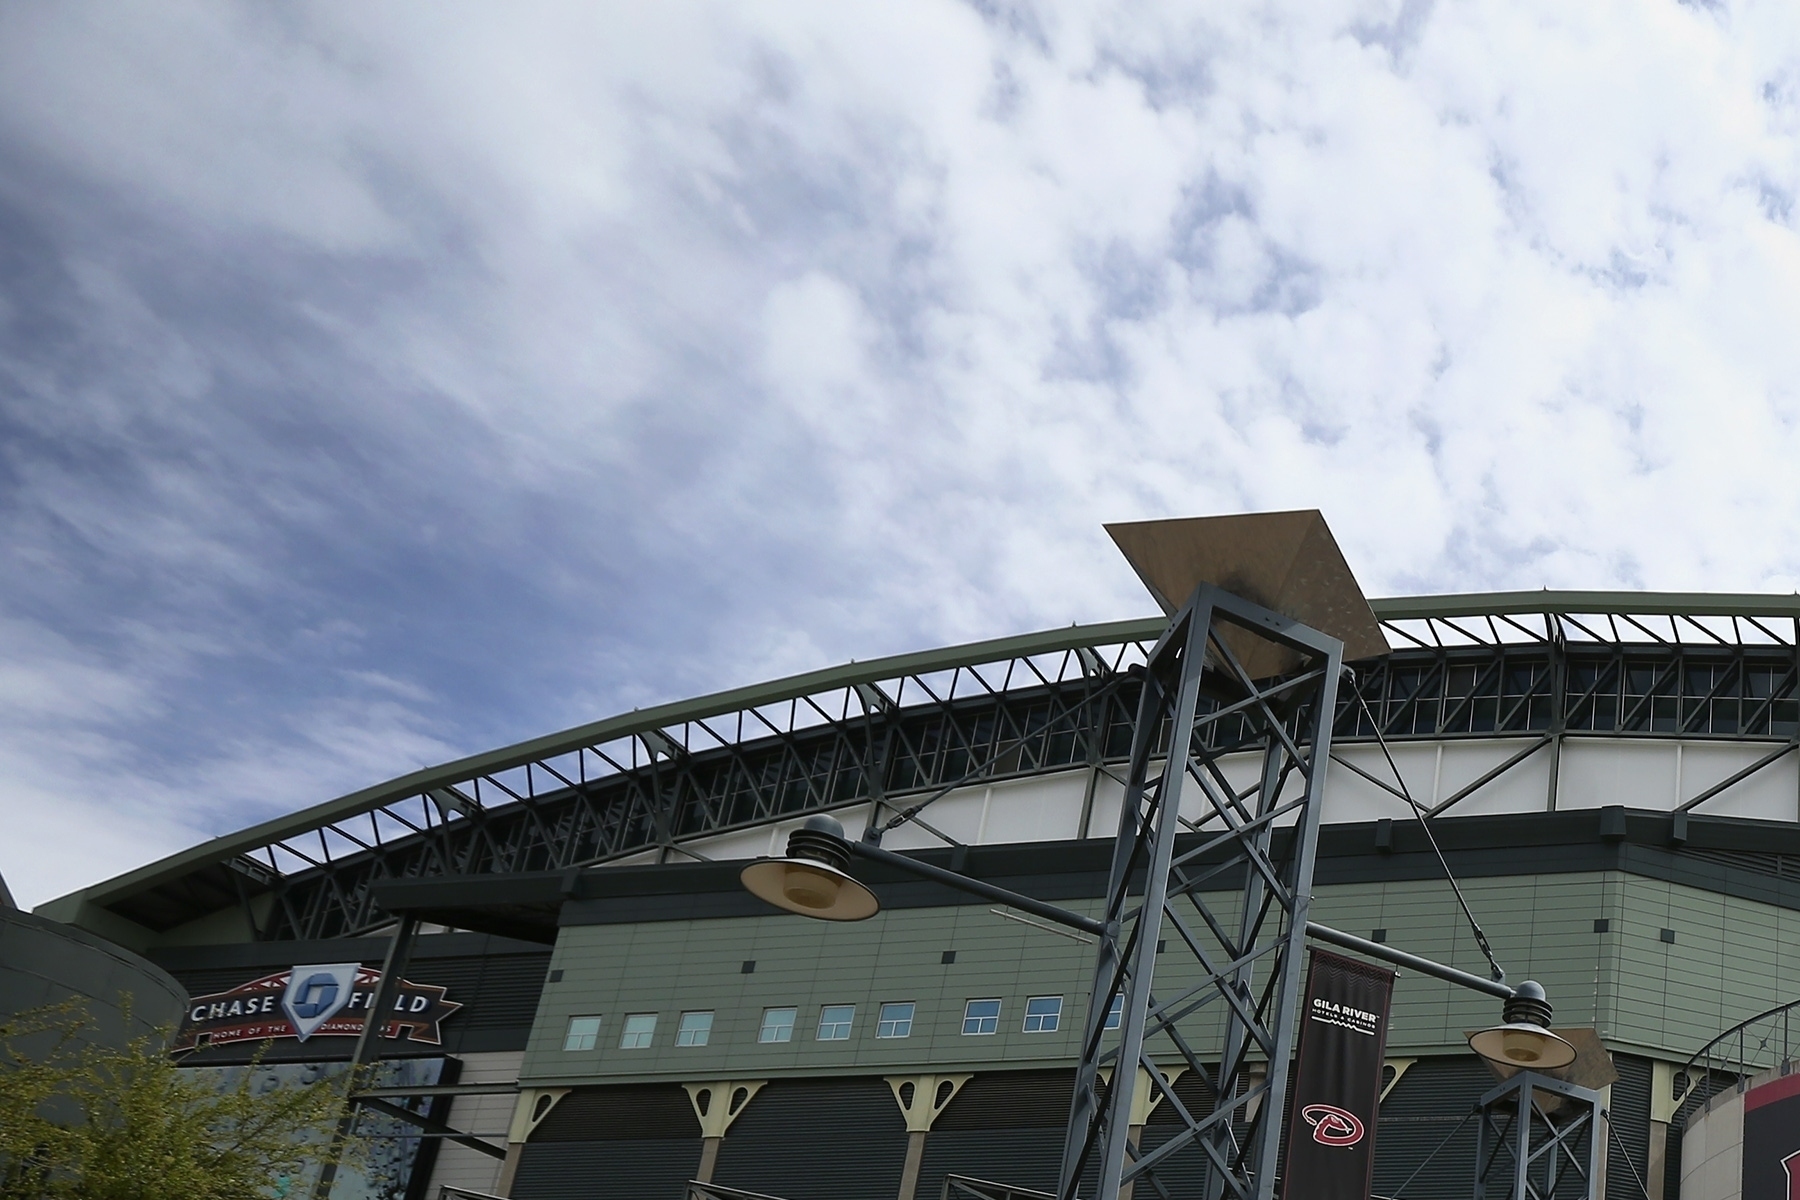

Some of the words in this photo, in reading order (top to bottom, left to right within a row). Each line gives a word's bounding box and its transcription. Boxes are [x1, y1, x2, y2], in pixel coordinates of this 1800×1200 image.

[191, 996, 275, 1022] CHASE
[349, 992, 432, 1014] FILD
[1312, 1008, 1338, 1018] HOTELS
[1347, 1017, 1376, 1029] CASINOS
[1313, 998, 1341, 1013] GILA
[1342, 1006, 1377, 1023] RIVER
[212, 1029, 242, 1040] HOME
[268, 1025, 287, 1033] THE
